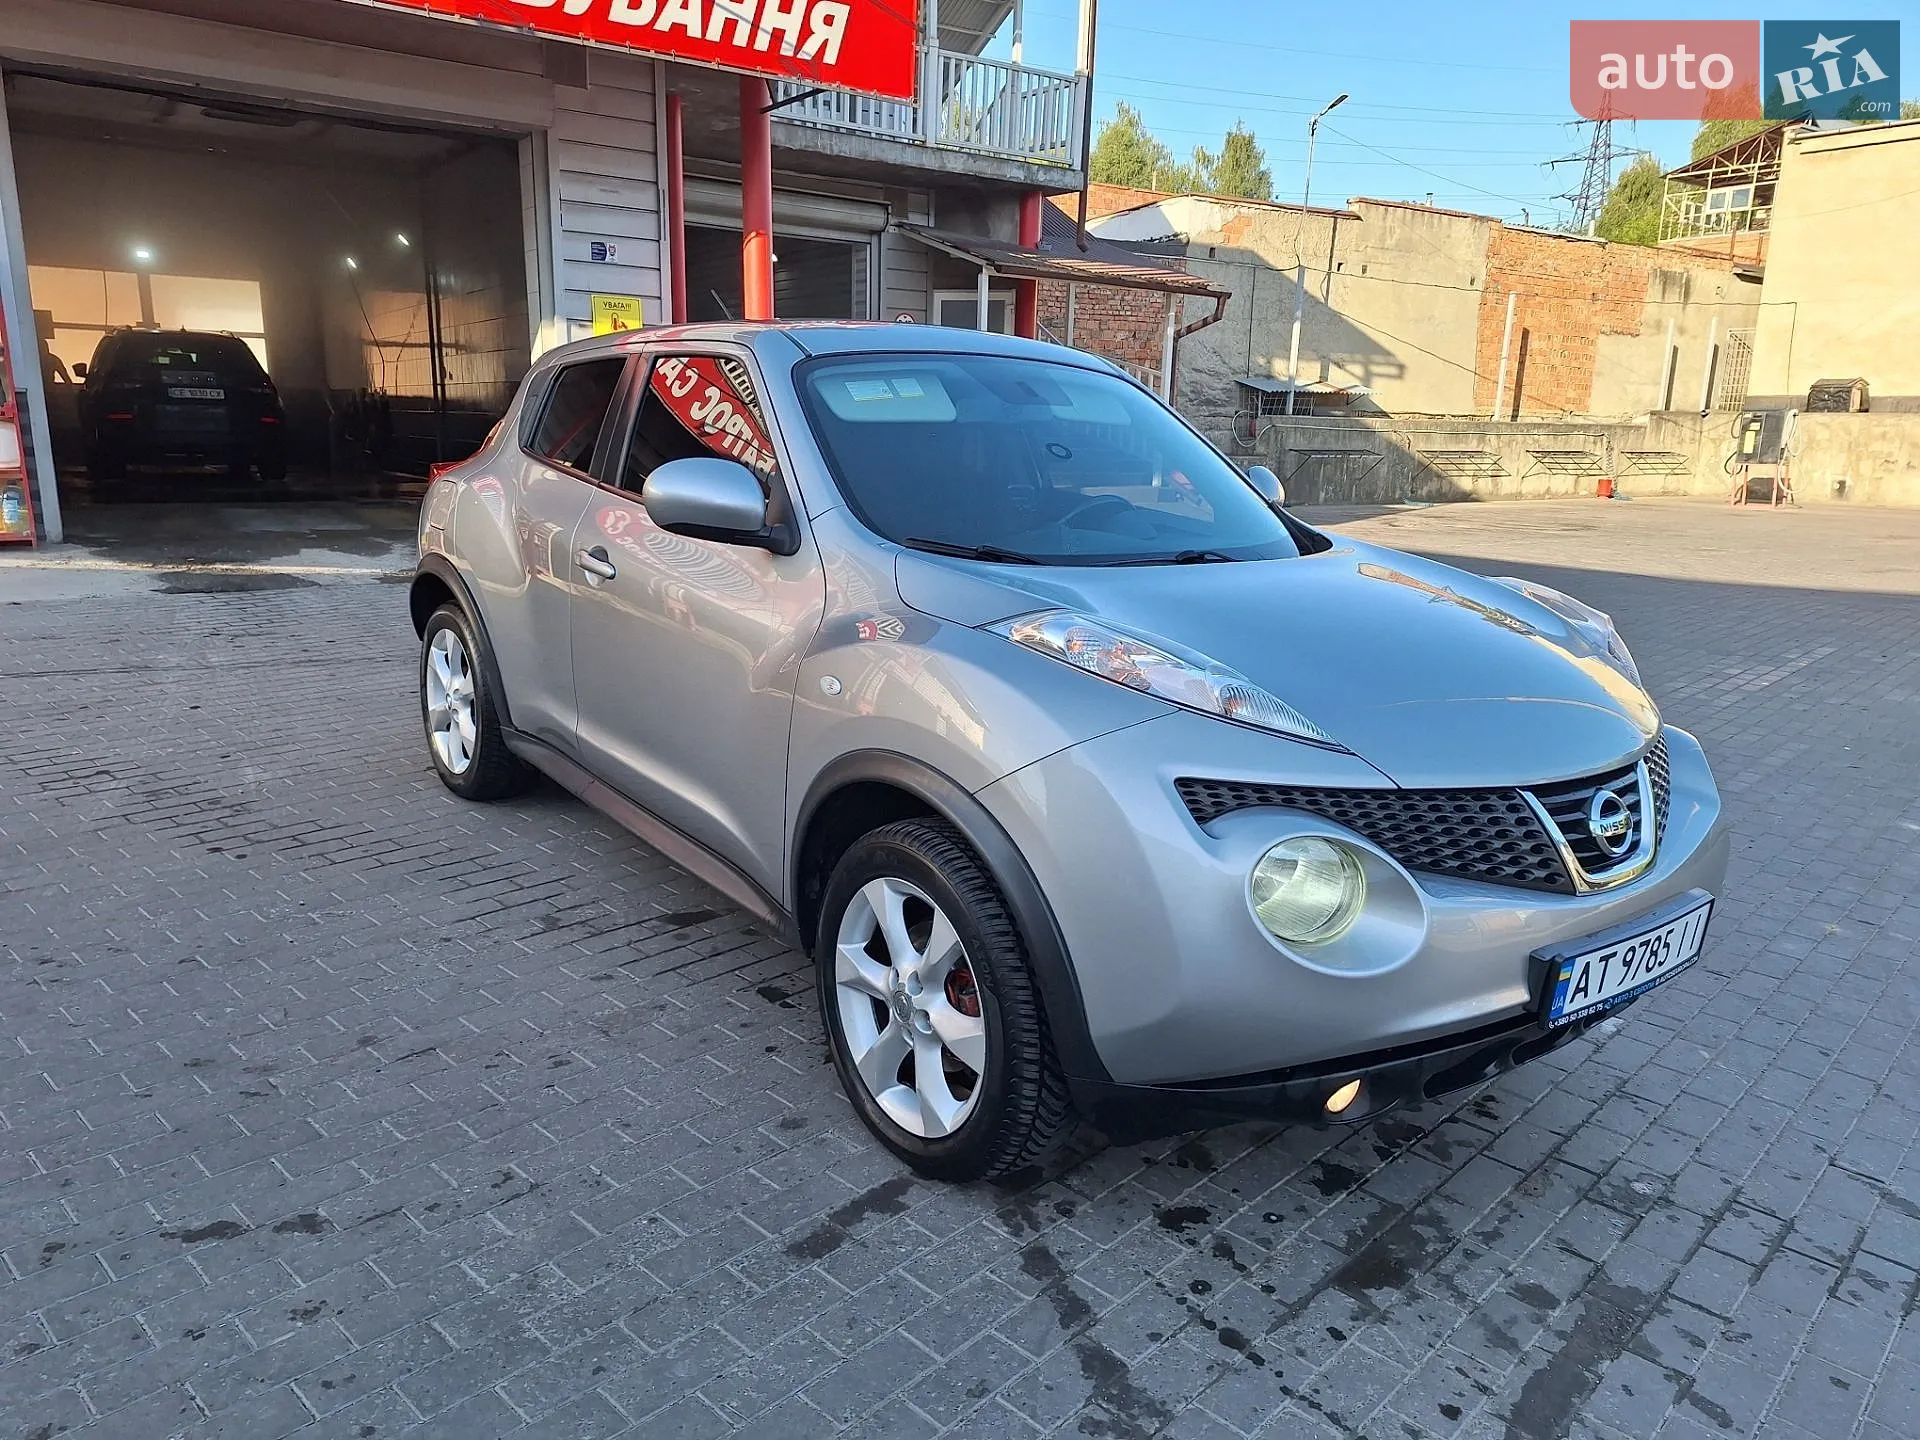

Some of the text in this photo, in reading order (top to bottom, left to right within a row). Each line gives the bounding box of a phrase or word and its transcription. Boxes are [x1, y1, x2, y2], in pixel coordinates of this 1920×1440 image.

[506, 0, 851, 66] АННЯ
[1600, 818, 1630, 834] NISS
[1569, 951, 1618, 1004] AT
[1617, 928, 1675, 987] 9785
[1551, 995, 1564, 1011] UA
